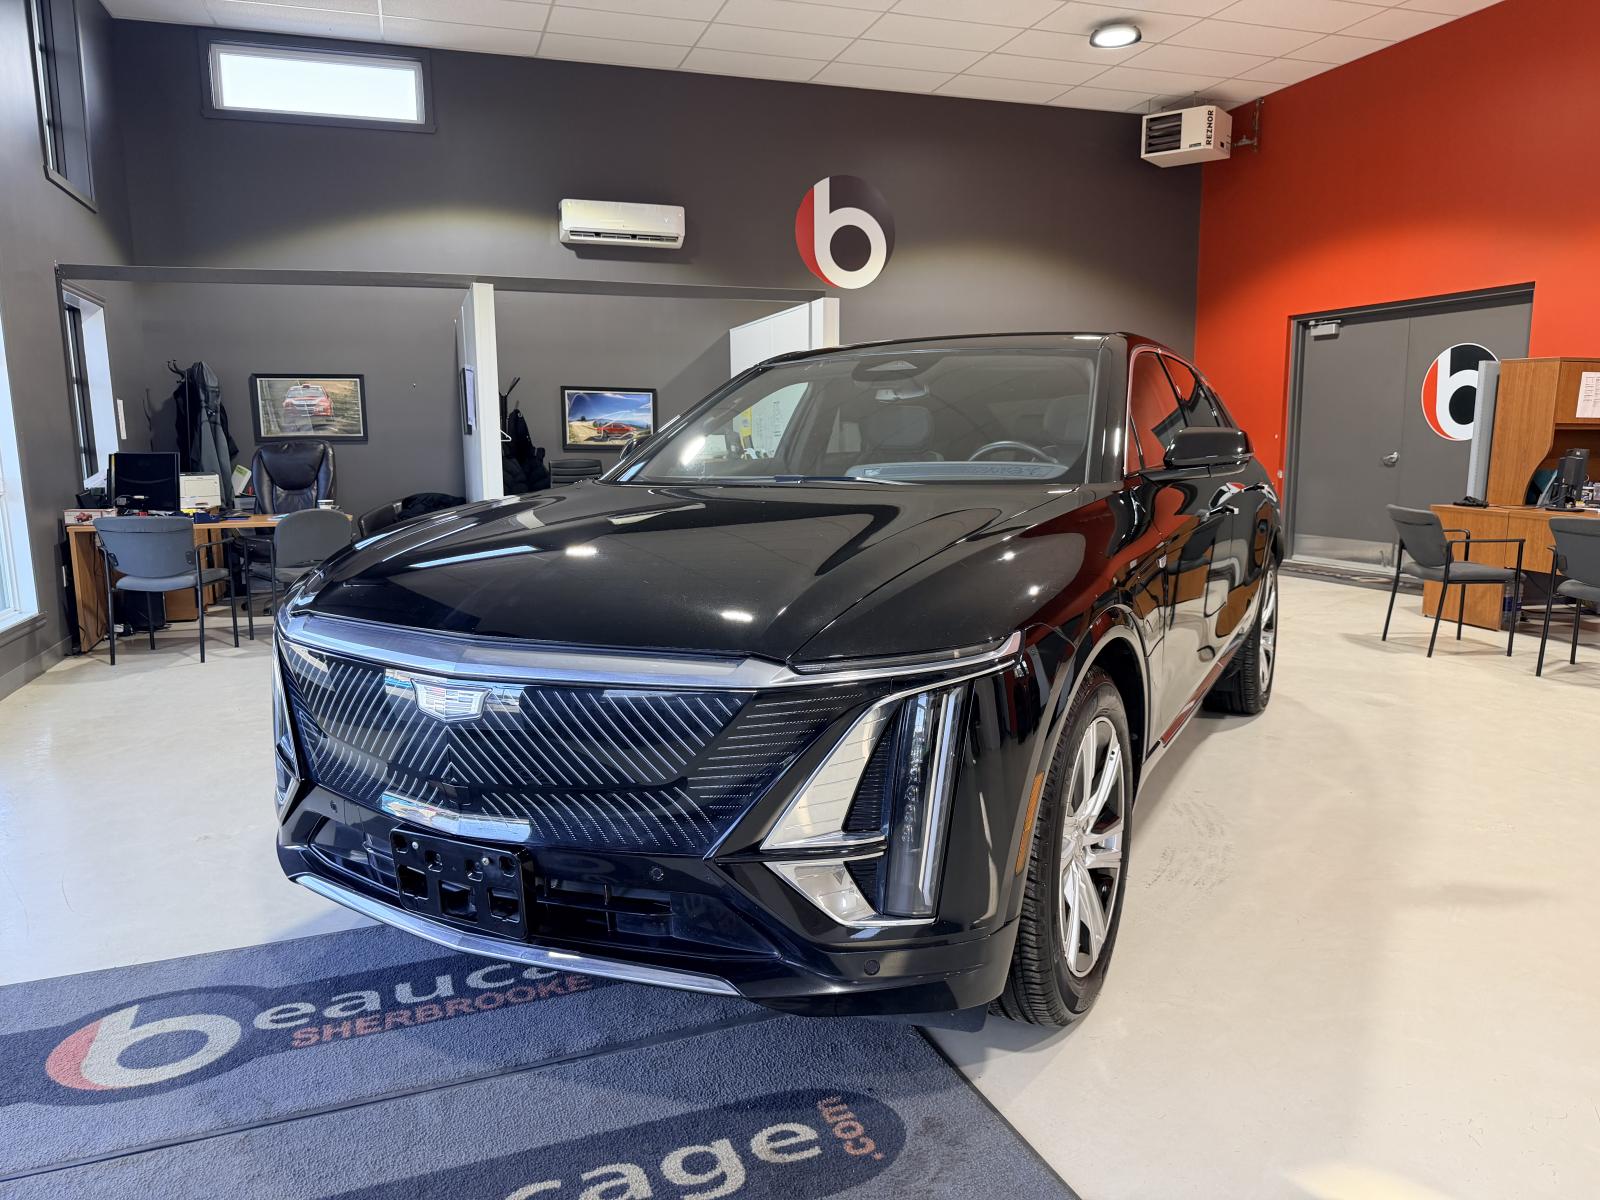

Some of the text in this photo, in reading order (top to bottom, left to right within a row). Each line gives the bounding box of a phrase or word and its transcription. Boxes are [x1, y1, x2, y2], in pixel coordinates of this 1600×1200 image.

[1206, 109, 1214, 145] REZNOR
[813, 176, 887, 290] b
[291, 974, 593, 1050] SHERBROOKE
